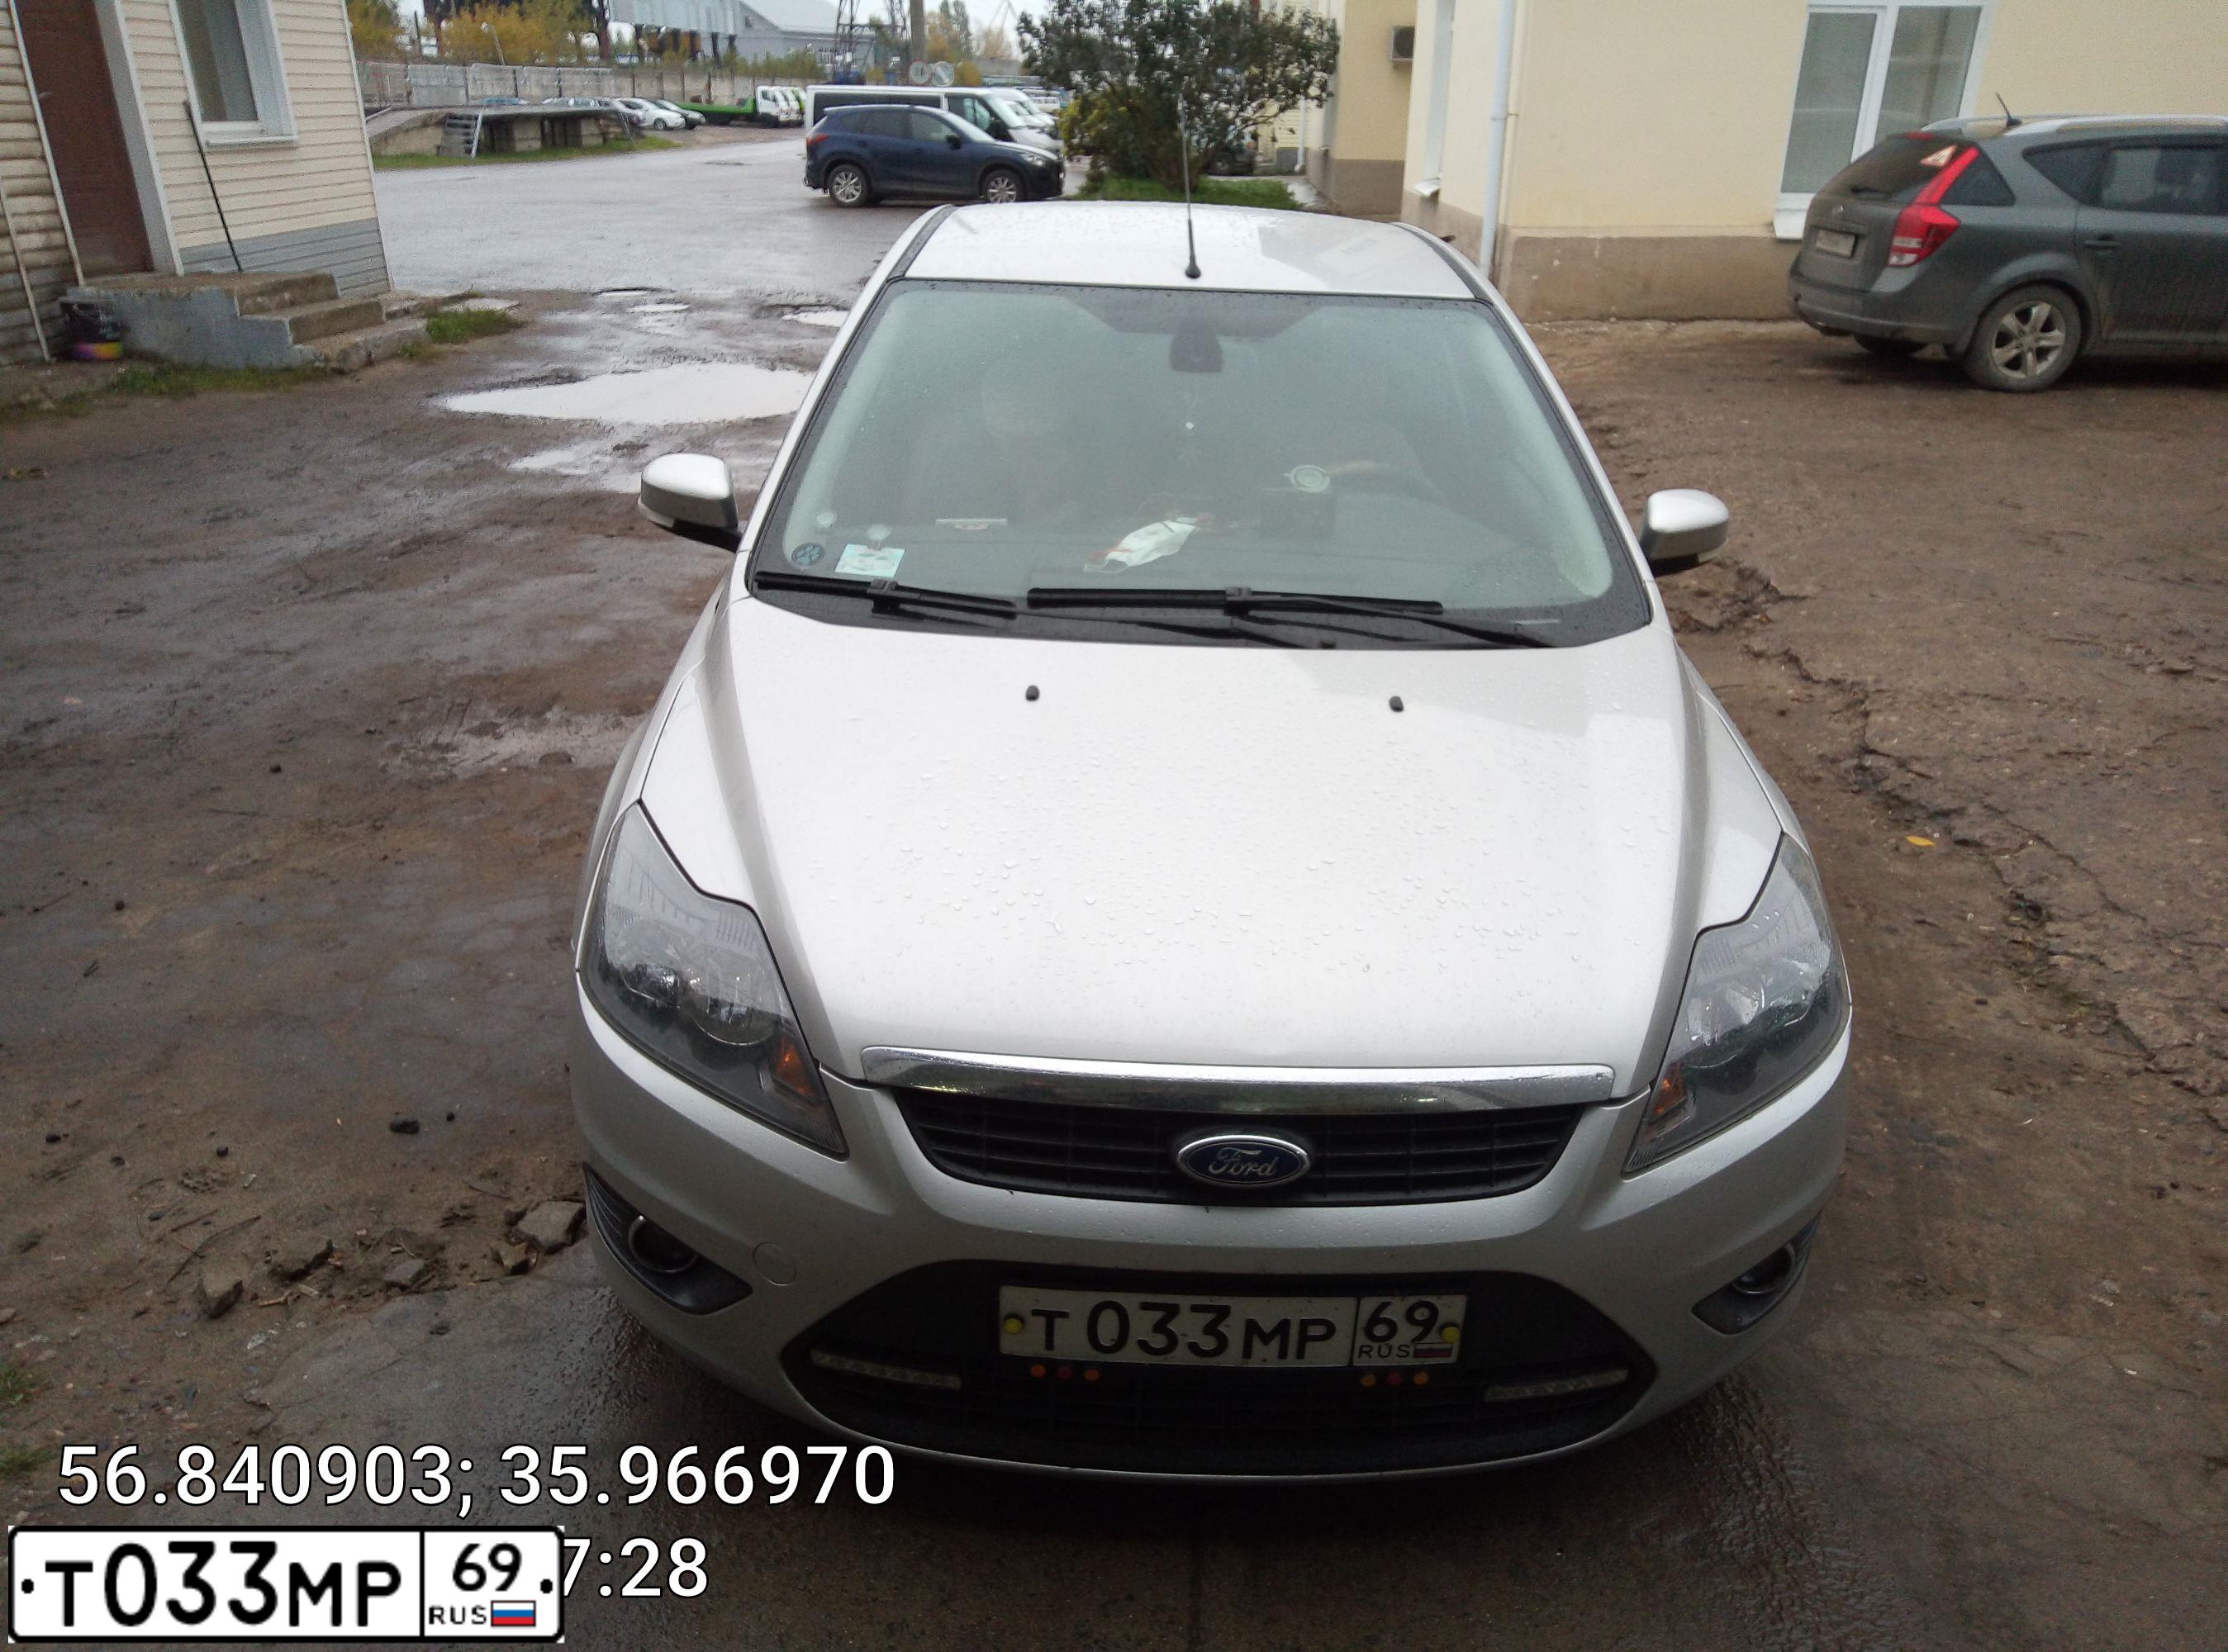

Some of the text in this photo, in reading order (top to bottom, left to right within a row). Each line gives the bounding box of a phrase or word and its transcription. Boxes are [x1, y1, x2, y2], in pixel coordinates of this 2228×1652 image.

[1208, 1146, 1280, 1177] Ford
[1364, 1300, 1439, 1343] 69
[1357, 1343, 1411, 1359] RUS
